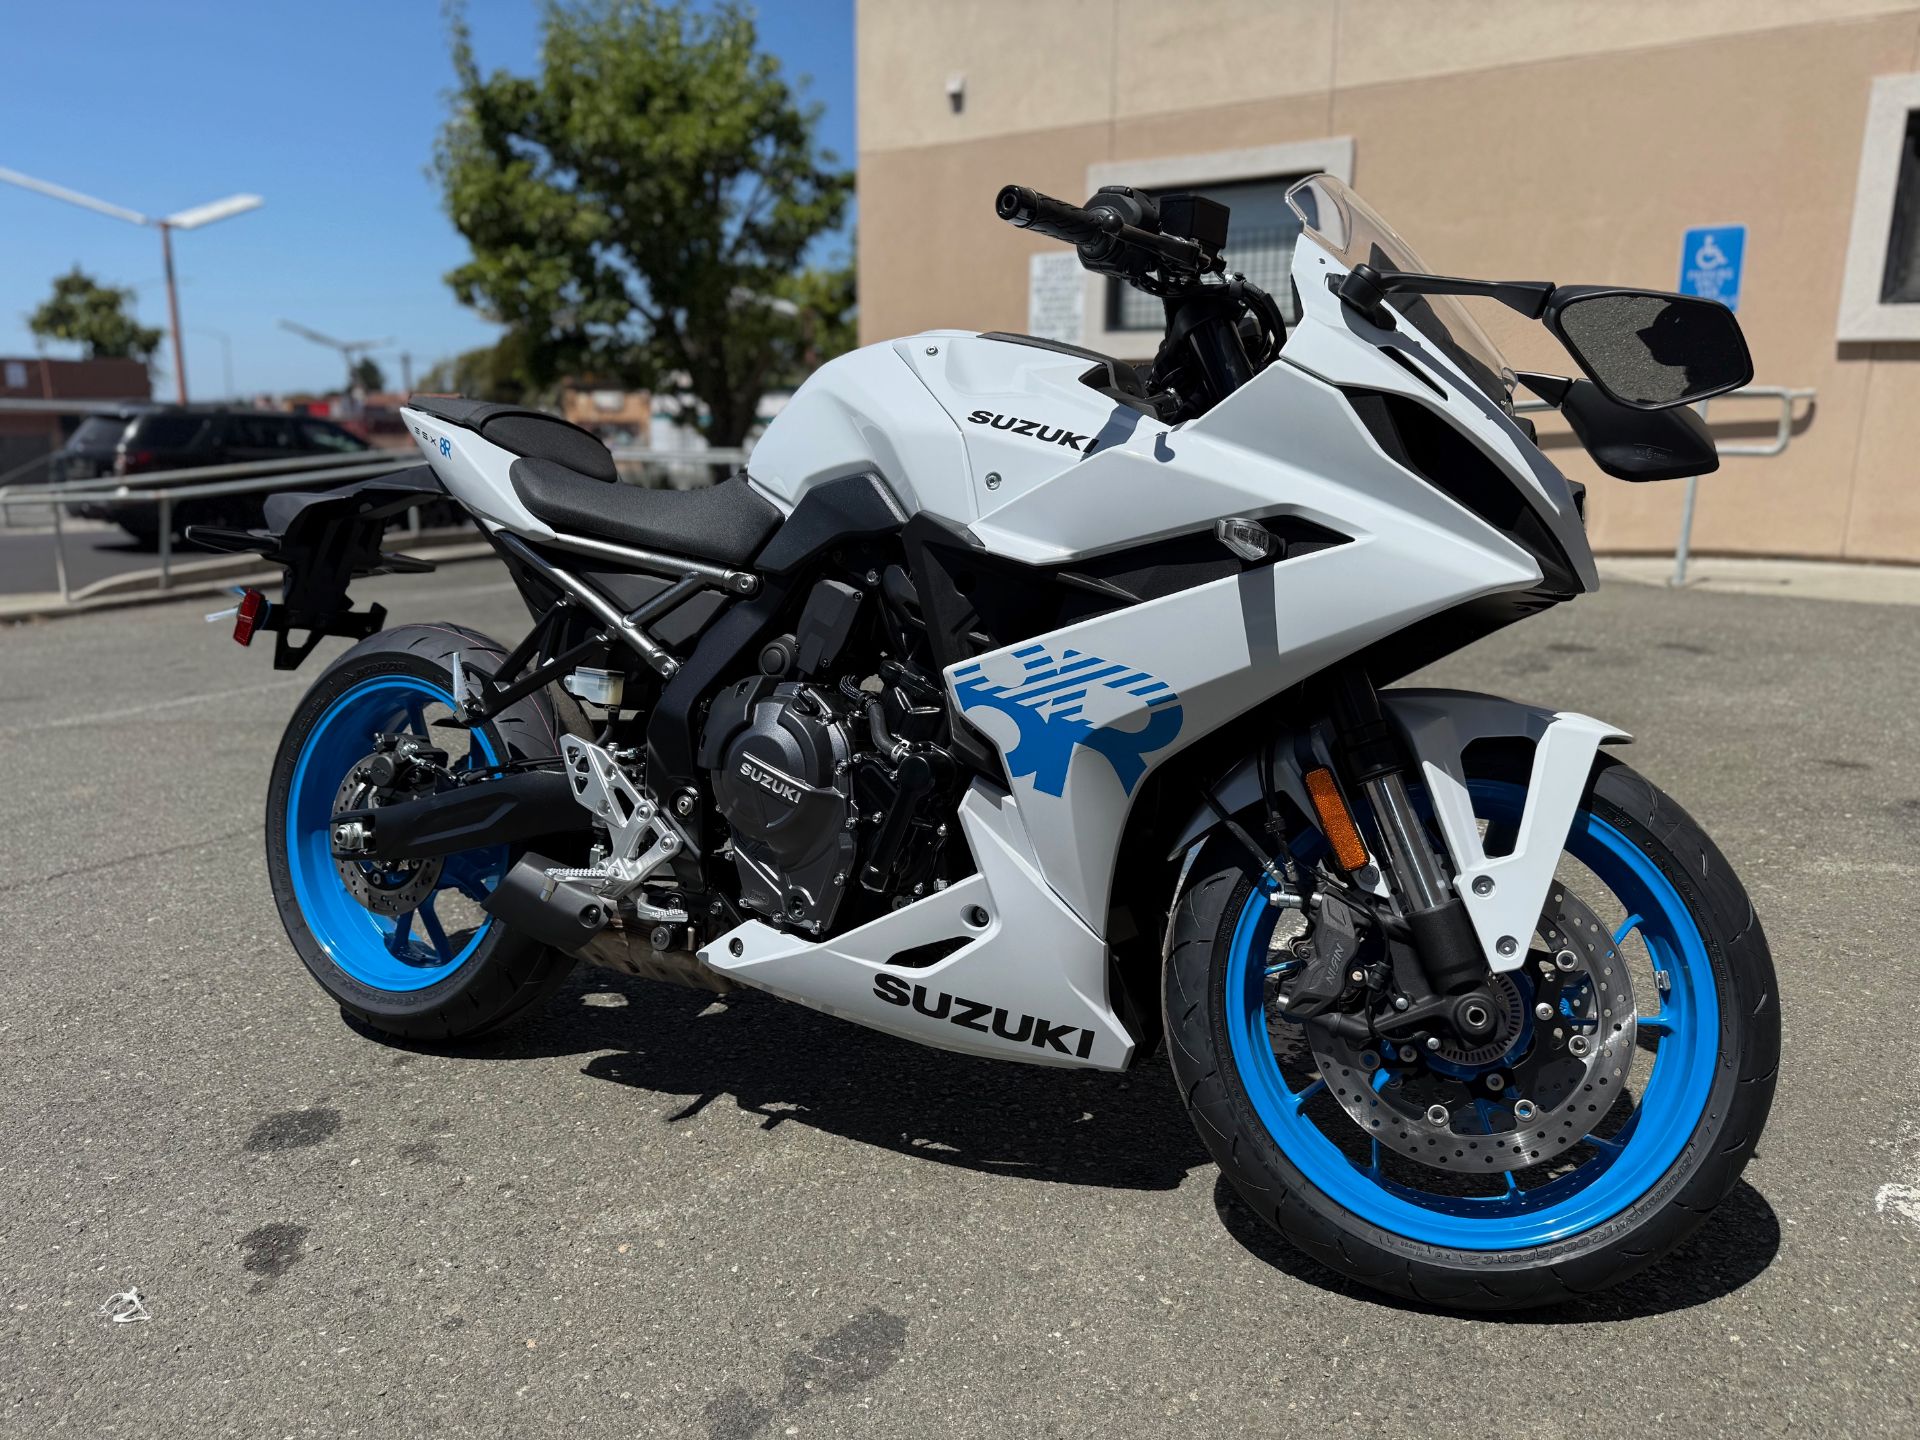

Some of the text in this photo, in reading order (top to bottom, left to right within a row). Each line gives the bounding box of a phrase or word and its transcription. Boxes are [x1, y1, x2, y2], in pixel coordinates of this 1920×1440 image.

[967, 410, 1100, 454] SUZUKI
[740, 762, 802, 804] SUZUKI
[872, 973, 1095, 1059] SUZUKI
